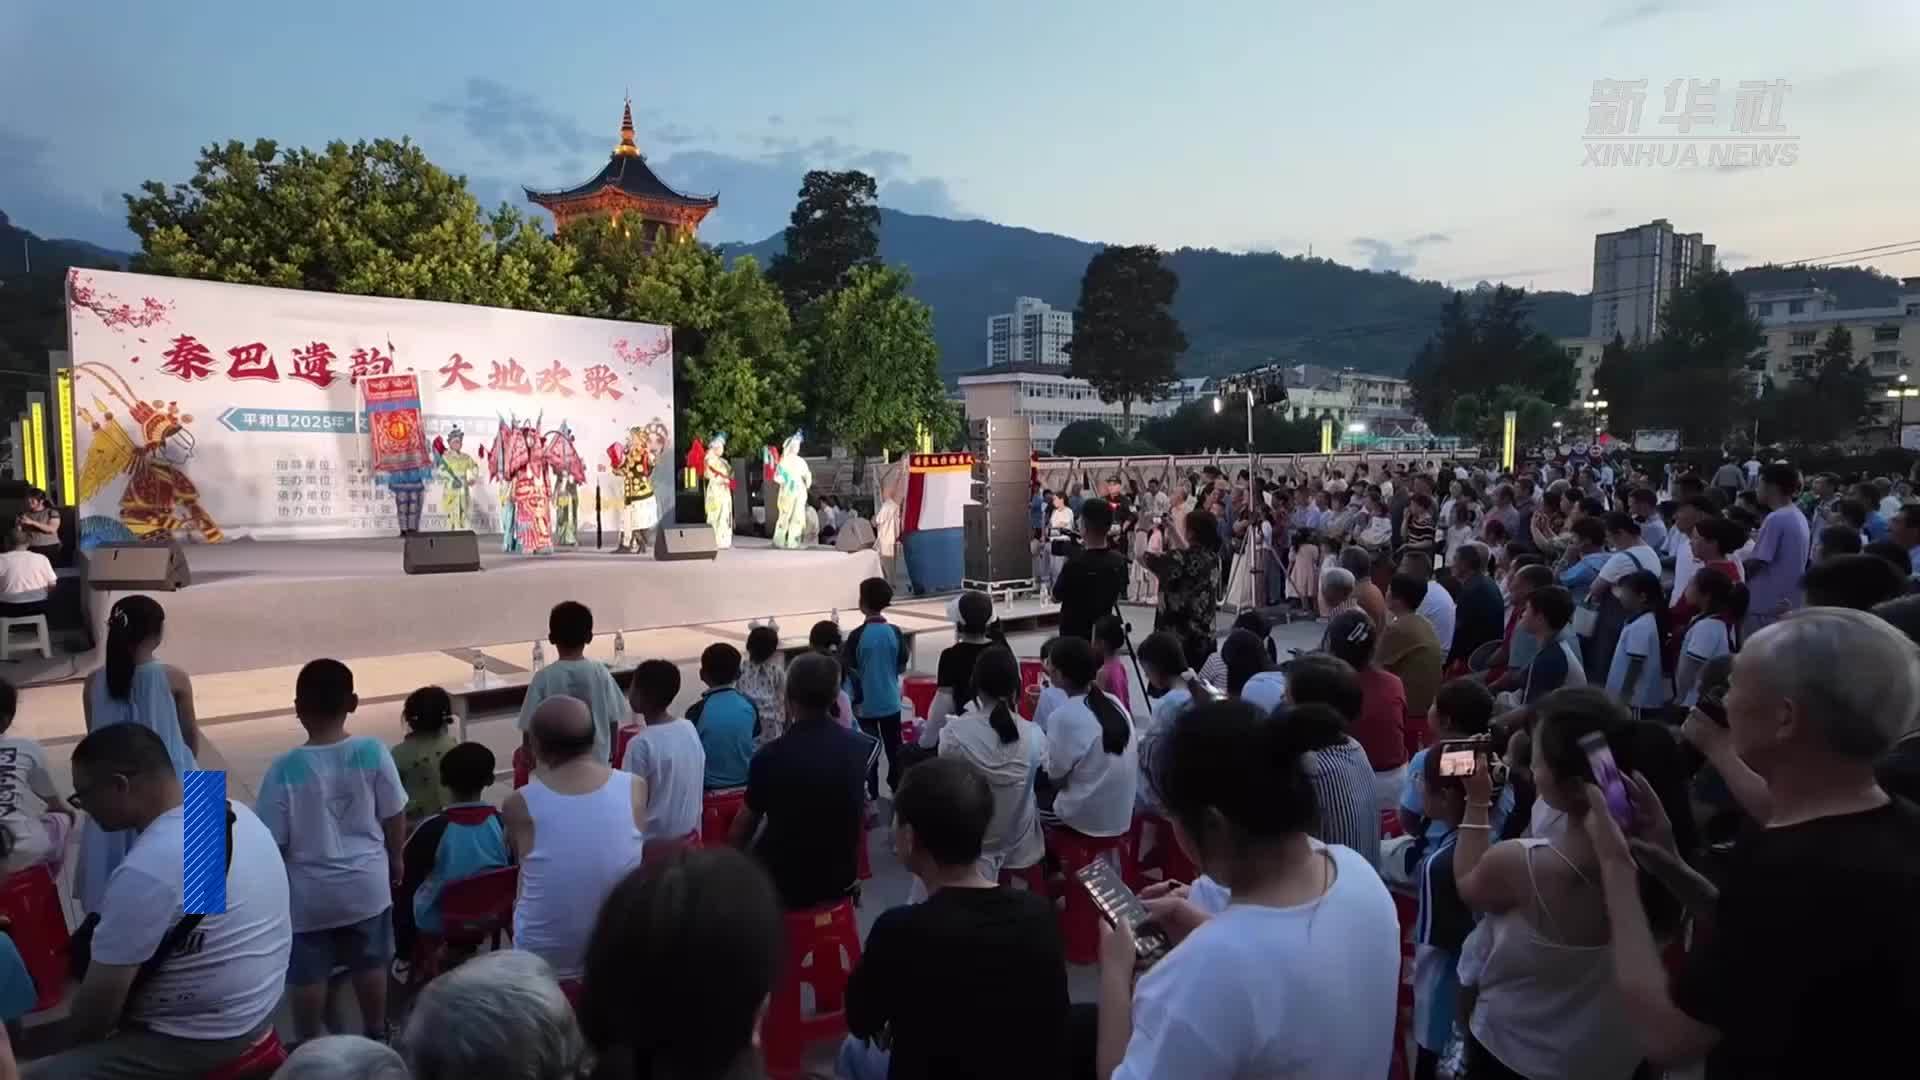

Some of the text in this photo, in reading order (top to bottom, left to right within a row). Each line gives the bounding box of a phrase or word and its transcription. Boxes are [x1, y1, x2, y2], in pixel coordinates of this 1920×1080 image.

[161, 334, 624, 400] 秦巴遗韵 大地欢歌
